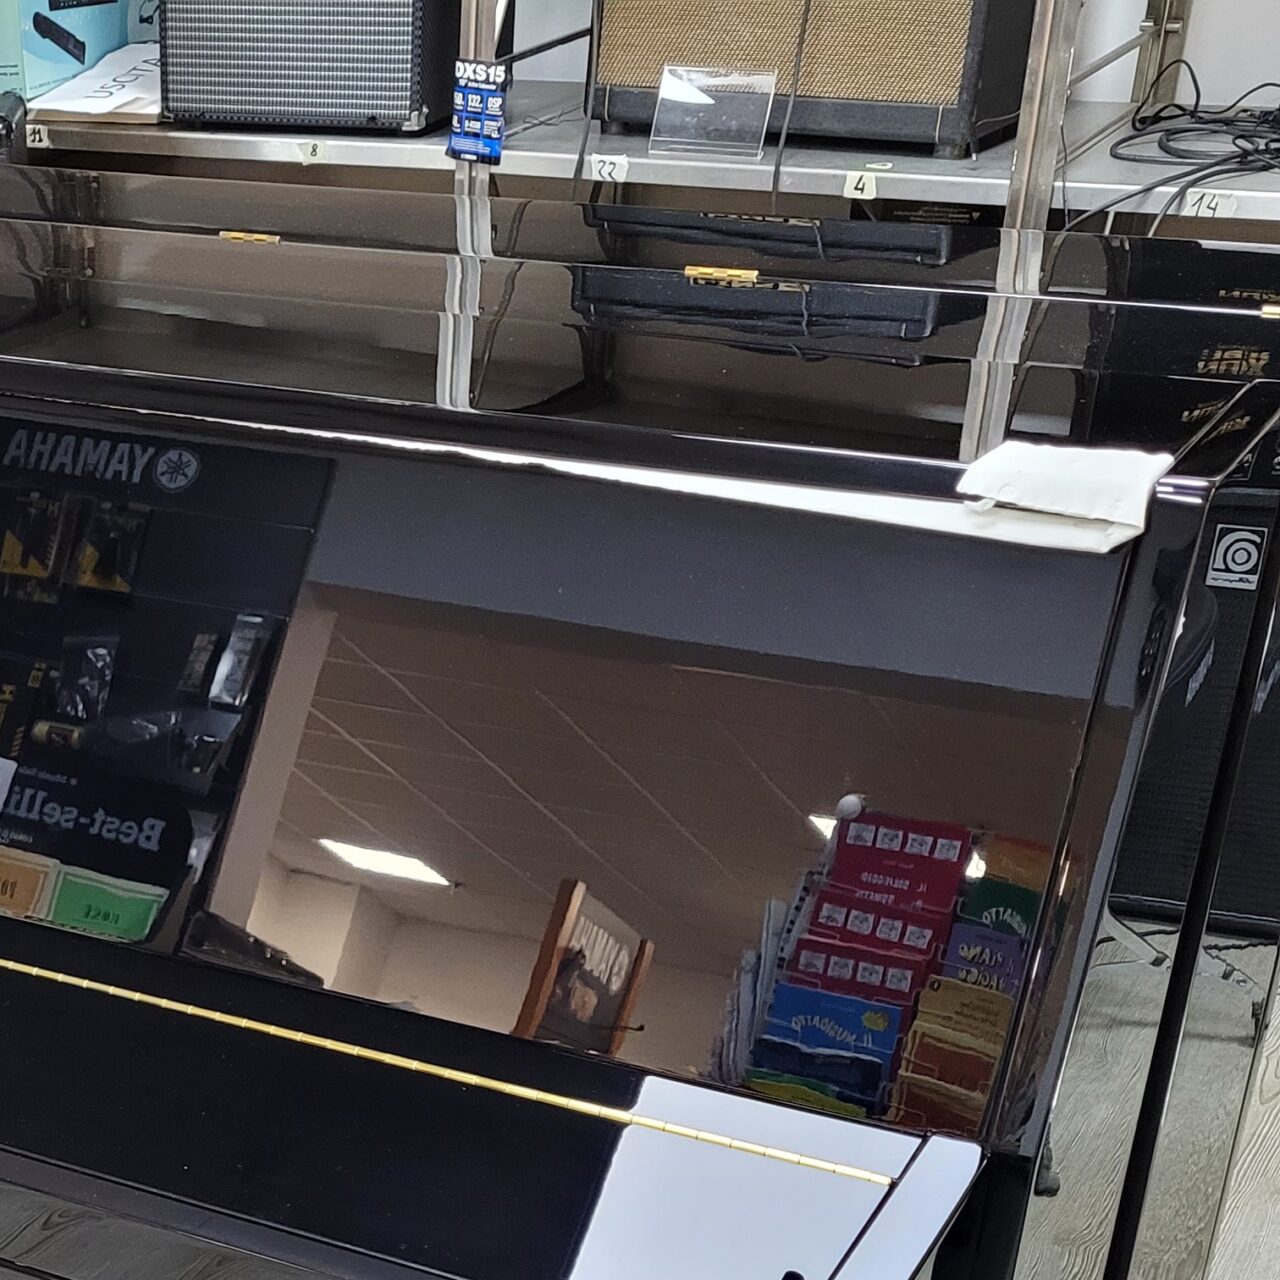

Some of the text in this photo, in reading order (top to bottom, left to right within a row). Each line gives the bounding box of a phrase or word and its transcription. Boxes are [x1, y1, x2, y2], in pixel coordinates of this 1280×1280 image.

[455, 61, 505, 83] DXS15
[309, 143, 319, 157] 8
[853, 175, 868, 194] 4
[1192, 193, 1219, 217] 14
